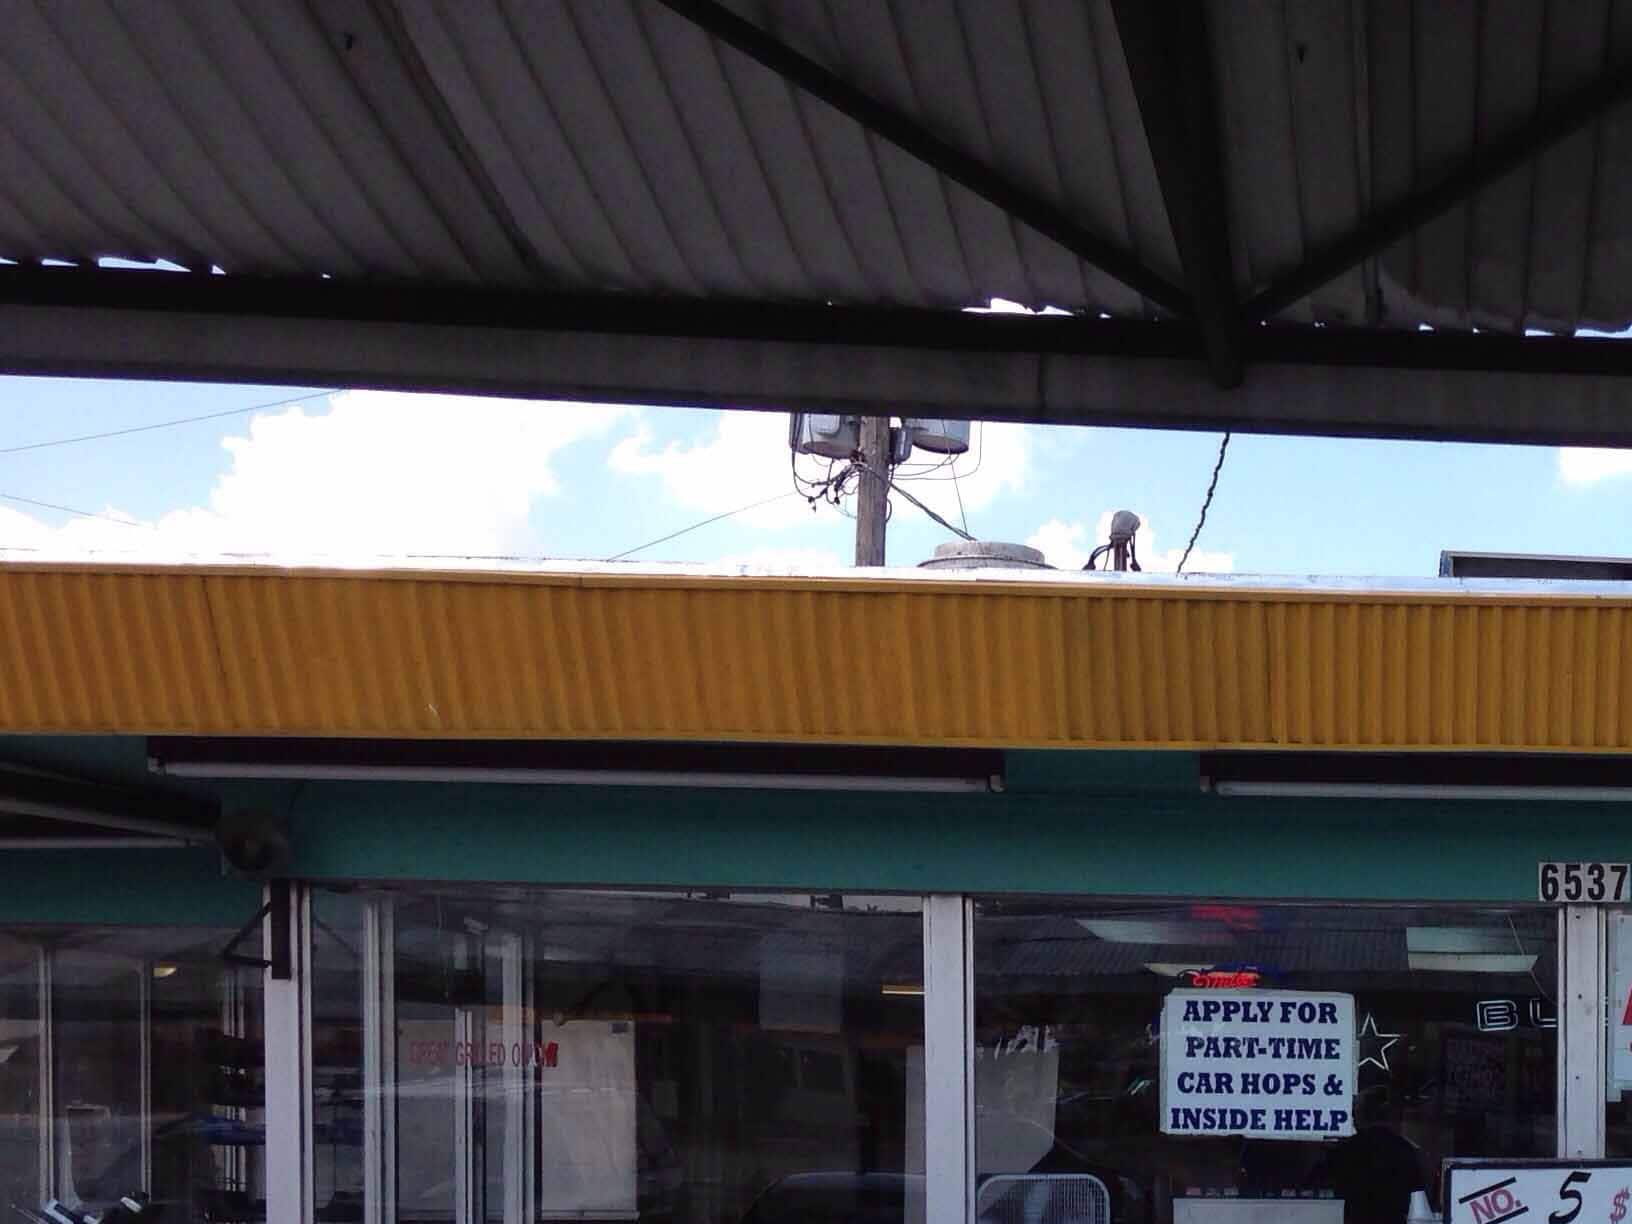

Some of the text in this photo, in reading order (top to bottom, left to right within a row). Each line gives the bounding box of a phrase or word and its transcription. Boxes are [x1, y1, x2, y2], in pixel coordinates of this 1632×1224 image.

[1542, 864, 1627, 900] 6537
[1183, 1001, 1338, 1024] APPLY FOR
[1186, 1037, 1340, 1059] PART-TIME
[1177, 1073, 1343, 1096] CAR HOPS &
[1171, 1108, 1348, 1131] INSIDE HELP
[1469, 1188, 1521, 1224] NO.
